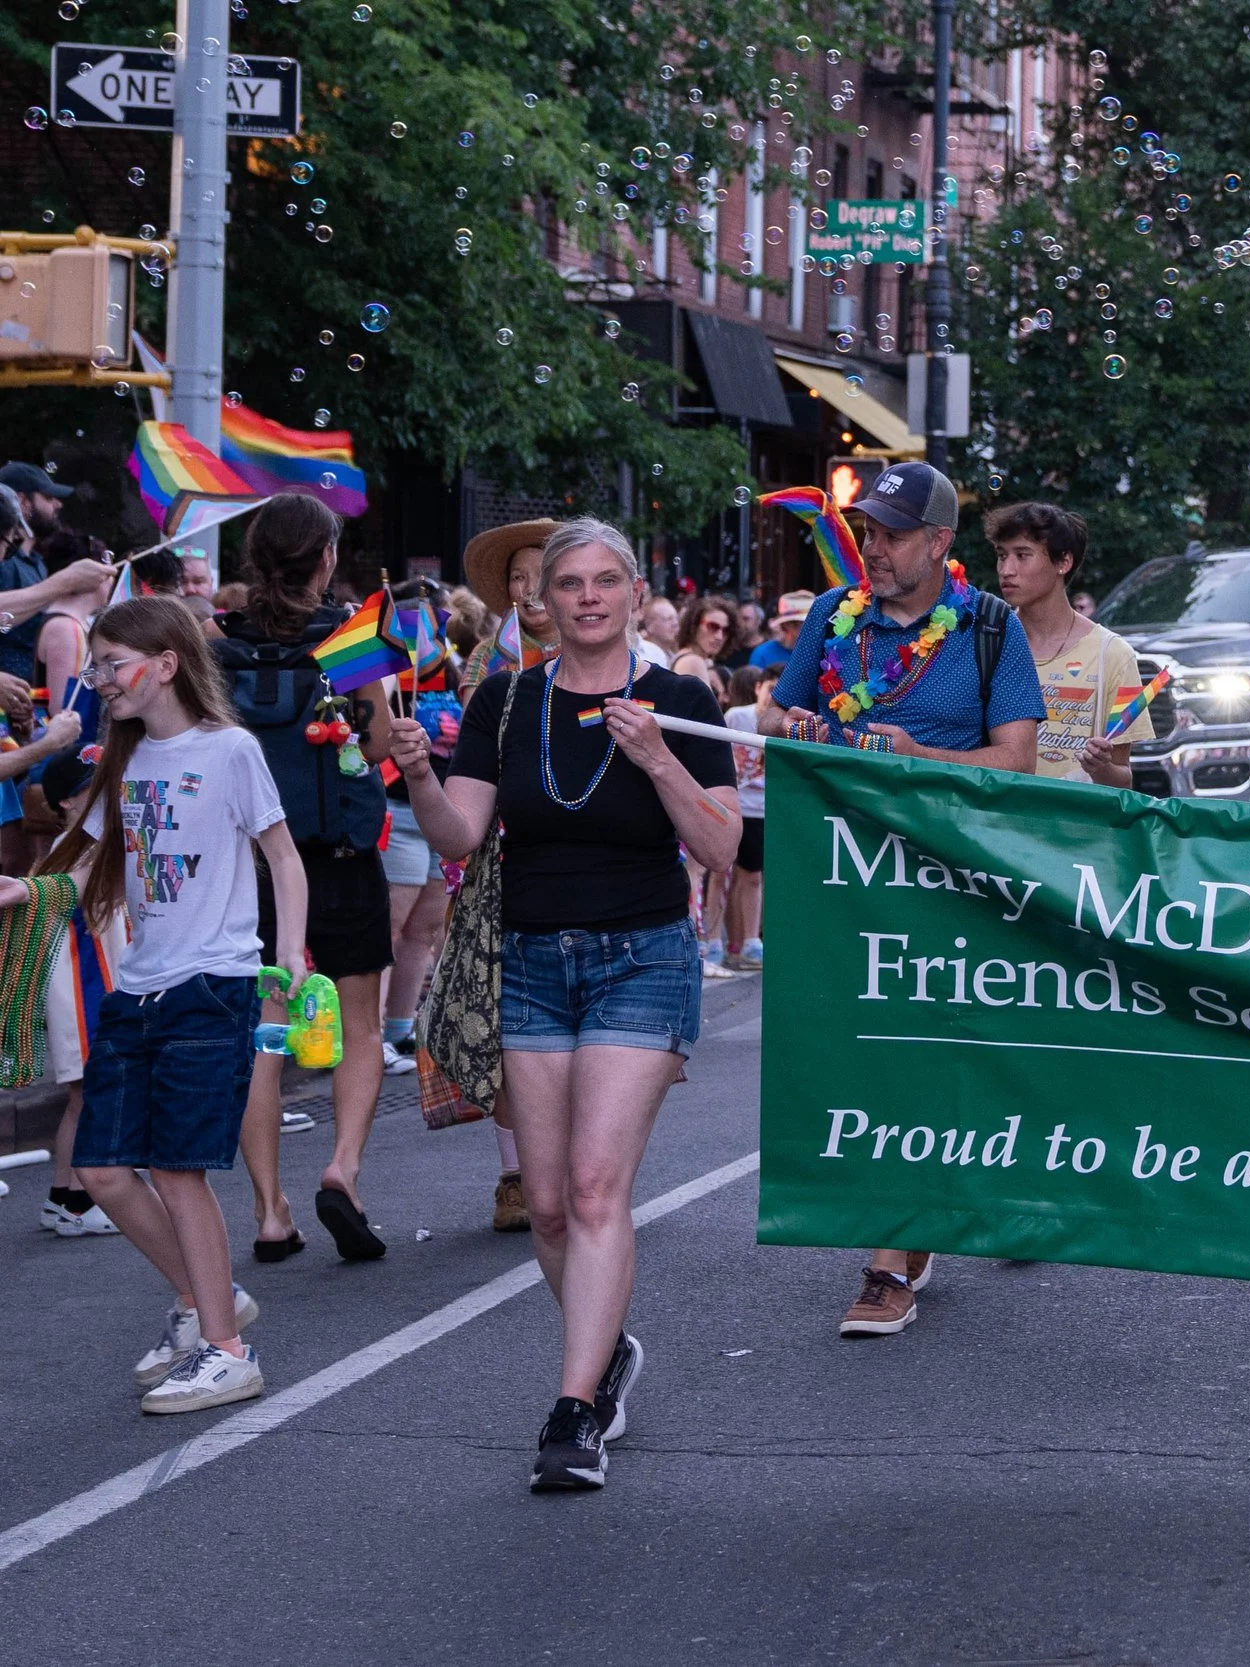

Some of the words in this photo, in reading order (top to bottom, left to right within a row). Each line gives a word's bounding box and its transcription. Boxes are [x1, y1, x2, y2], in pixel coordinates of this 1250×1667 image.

[101, 72, 171, 104] ONE
[226, 82, 264, 110] AY
[837, 202, 898, 230] Degraw
[1037, 721, 1089, 752] ustan
[141, 804, 179, 830] ALL
[124, 828, 158, 853] DAY
[136, 853, 202, 879] EVERY
[823, 816, 1042, 922] Mary
[144, 877, 183, 903] DAY
[858, 932, 1166, 1016] Friends
[819, 1109, 1022, 1168] Proud
[1045, 1123, 1106, 1174] to
[1131, 1125, 1201, 1182] be
